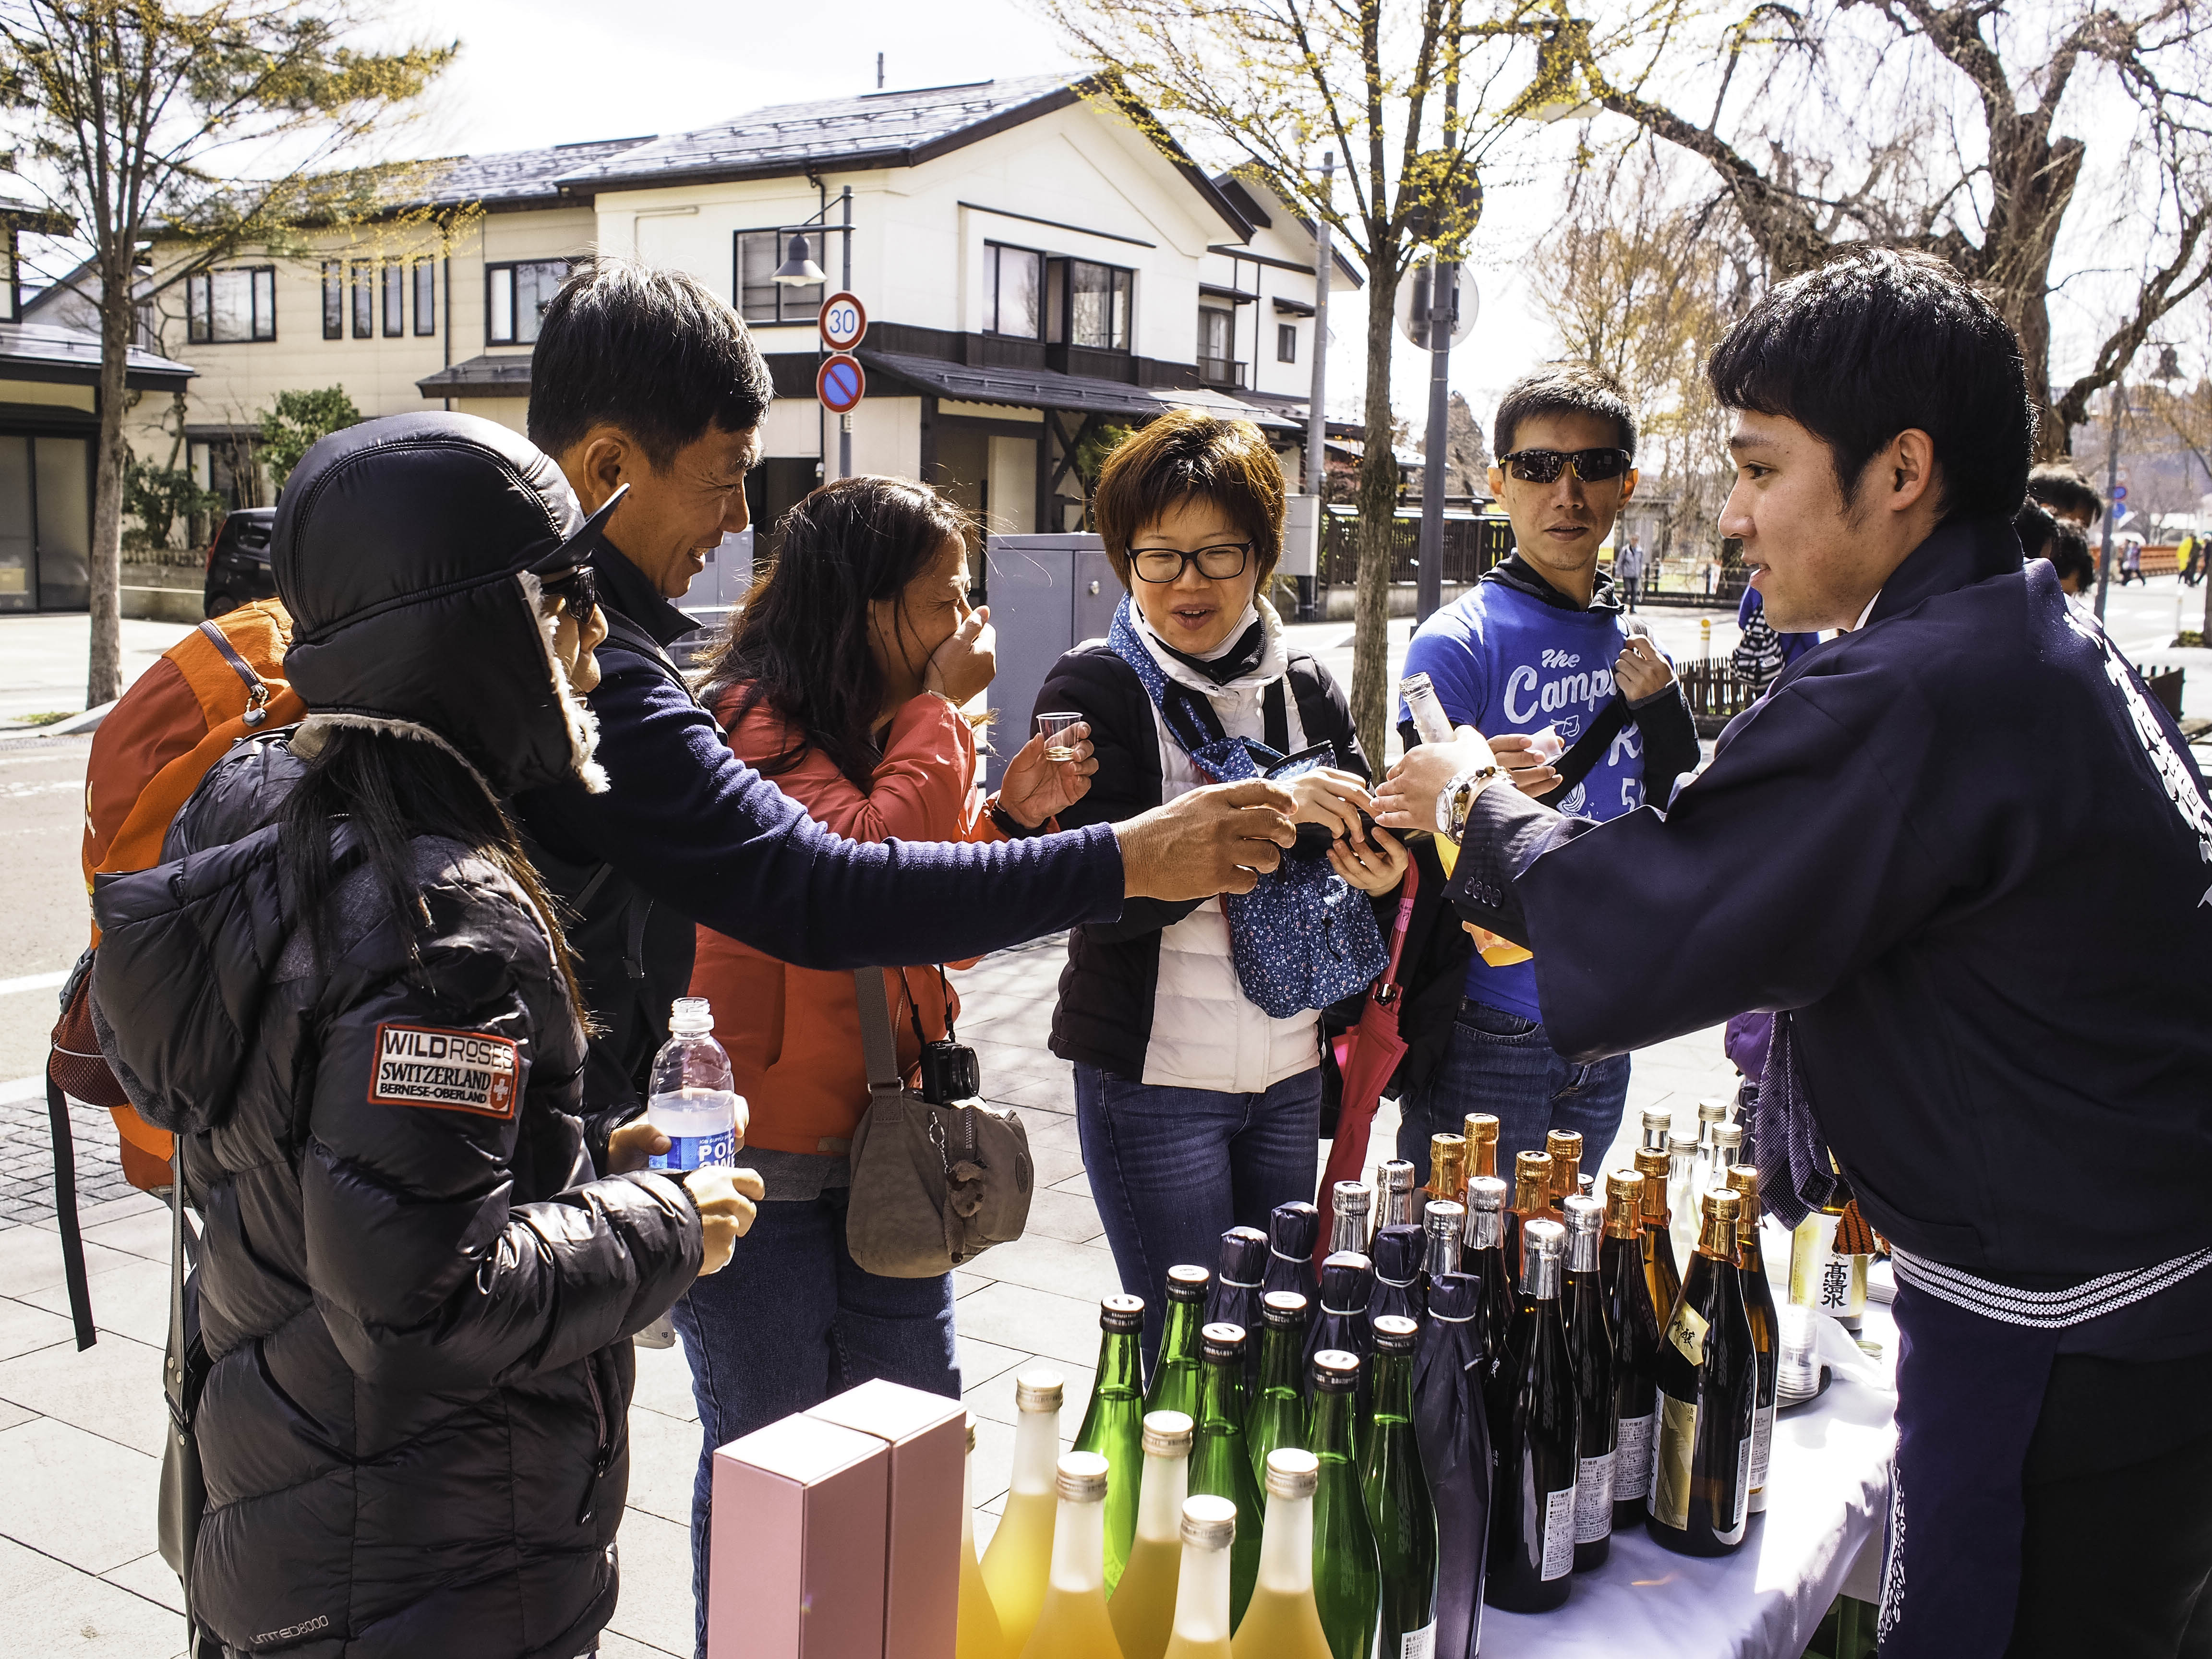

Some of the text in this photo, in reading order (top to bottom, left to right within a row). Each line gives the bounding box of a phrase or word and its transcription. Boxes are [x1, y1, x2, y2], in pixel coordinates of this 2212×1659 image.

[830, 310, 854, 334] 30
[1541, 649, 1580, 668] The
[385, 1032, 514, 1070] WILDROSES
[381, 1062, 491, 1091] SWITZERLAND
[380, 1082, 487, 1104] BERNESE-OBERLAND
